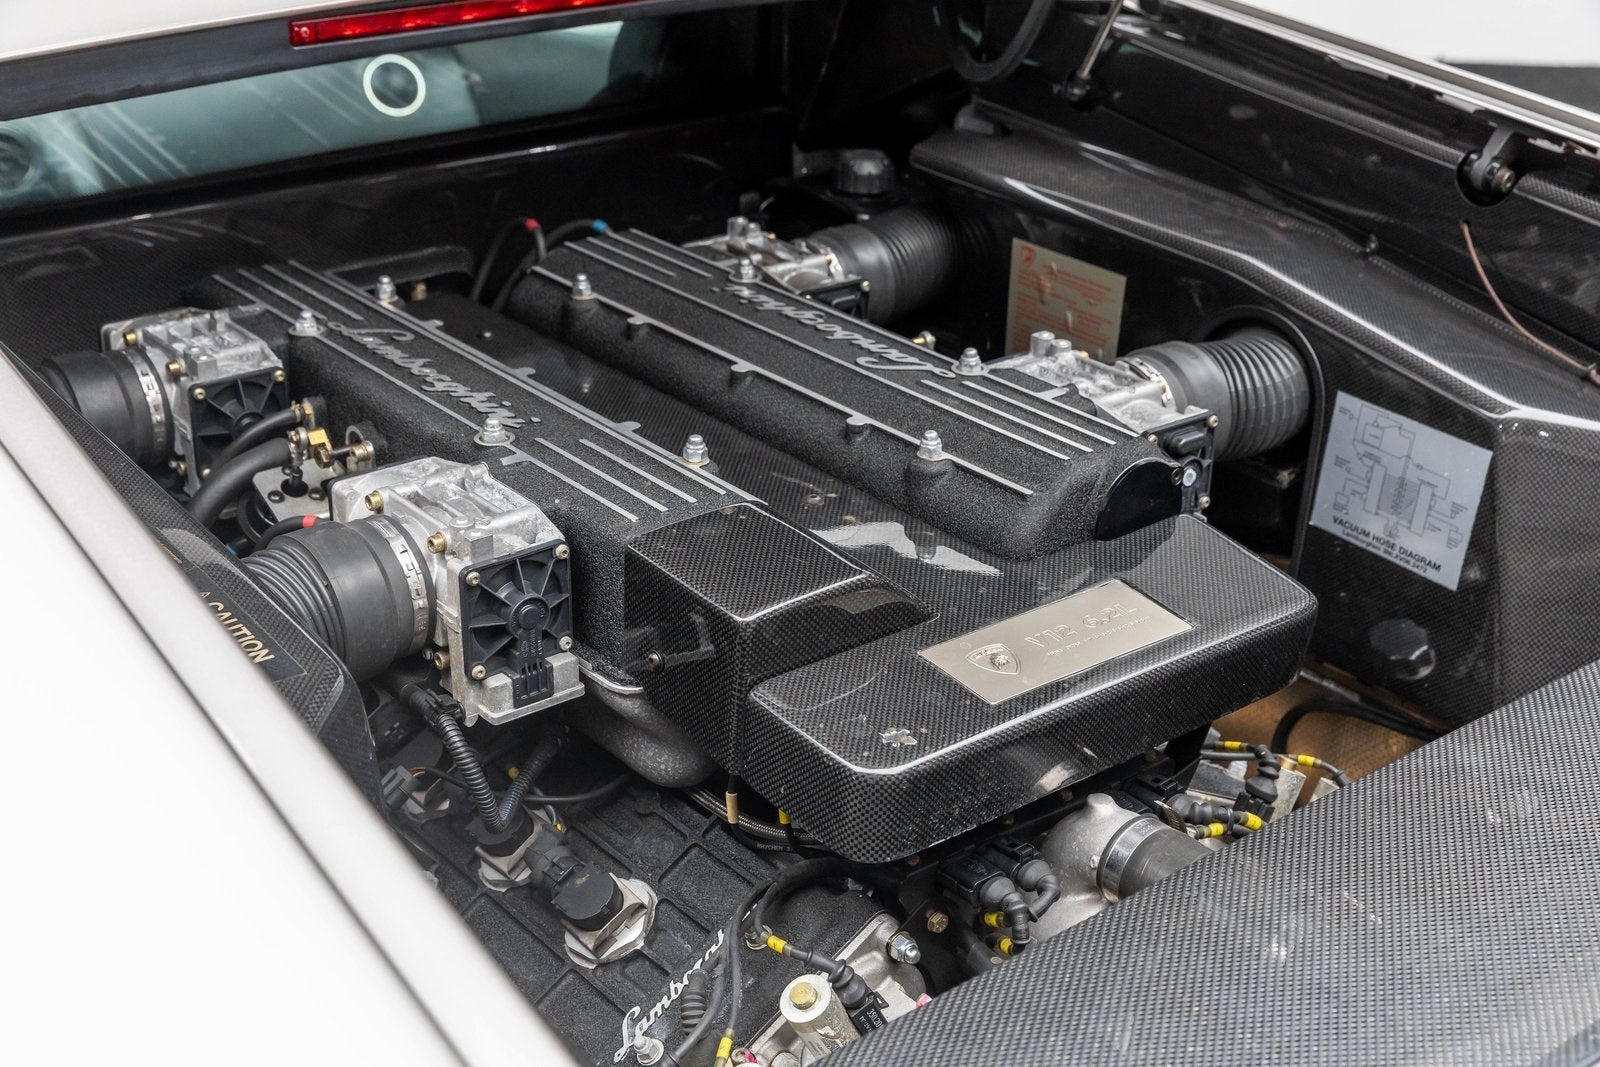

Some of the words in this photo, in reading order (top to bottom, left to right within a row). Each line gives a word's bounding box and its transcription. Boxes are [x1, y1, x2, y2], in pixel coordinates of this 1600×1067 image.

[1332, 515, 1371, 538] VACUUM
[1371, 534, 1398, 551] HOSE
[1399, 546, 1442, 573] DIAGRAM
[208, 601, 276, 664] CAUTION
[1024, 624, 1078, 648] V12
